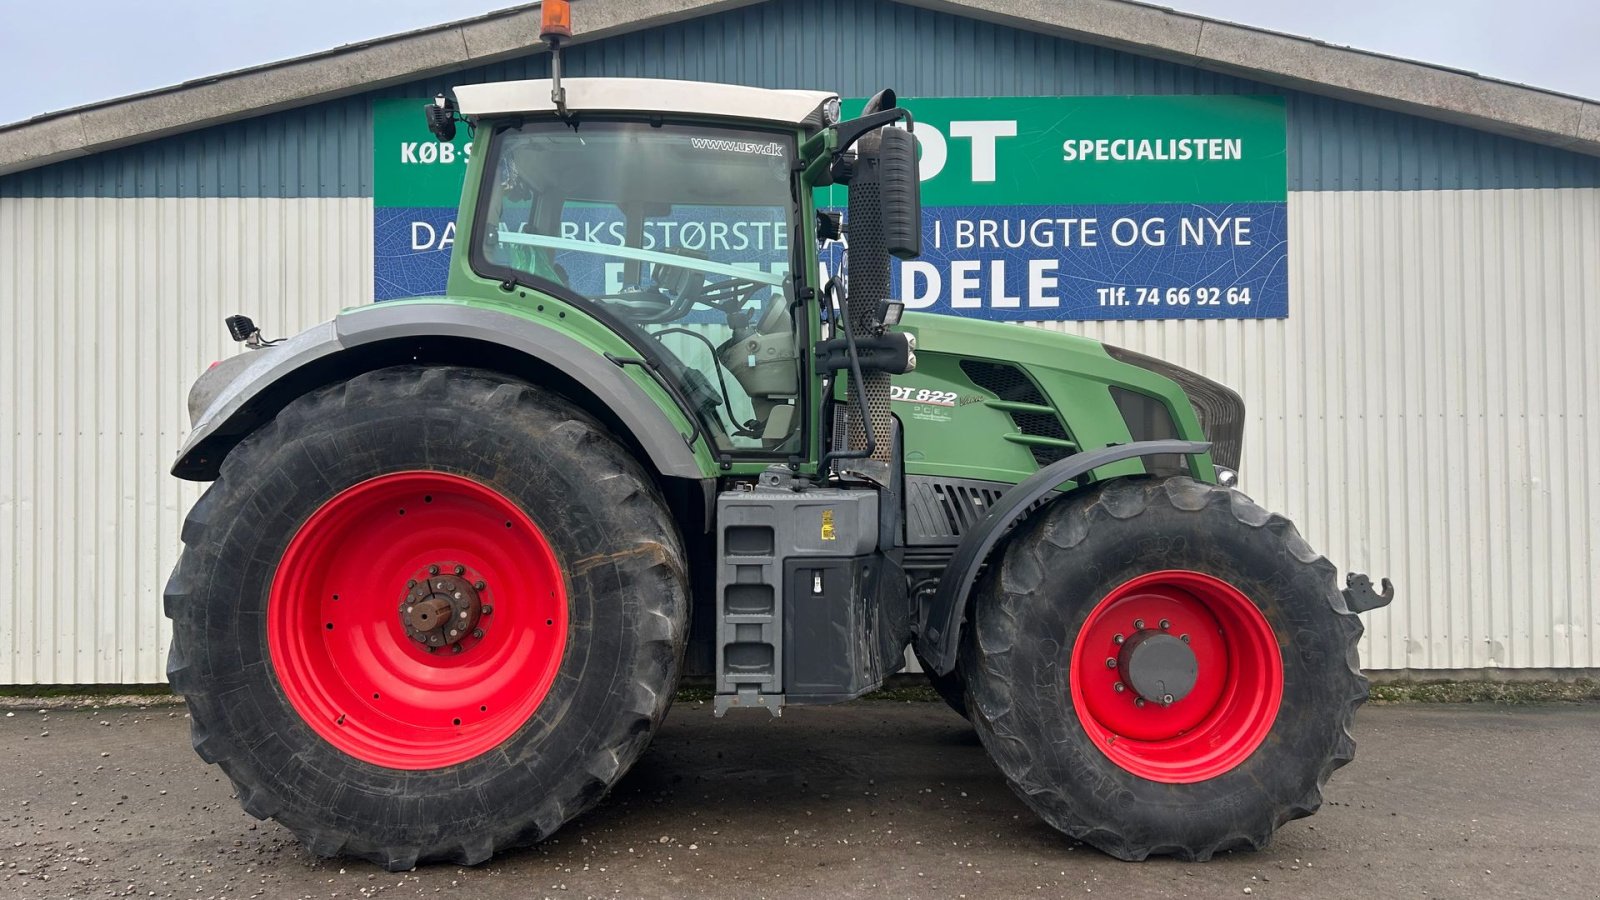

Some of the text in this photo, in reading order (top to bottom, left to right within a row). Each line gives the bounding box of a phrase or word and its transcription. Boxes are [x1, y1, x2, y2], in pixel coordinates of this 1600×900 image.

[691, 138, 783, 157] www.usv.dk
[1063, 139, 1242, 162] SPECIALISTEN
[935, 220, 941, 248] I
[956, 218, 1097, 248] BRUGTE
[1112, 217, 1166, 247] OG
[1181, 217, 1251, 246] NYE
[1097, 287, 1251, 306] Tlf. 74 66 92 64
[916, 389, 958, 404] 822
